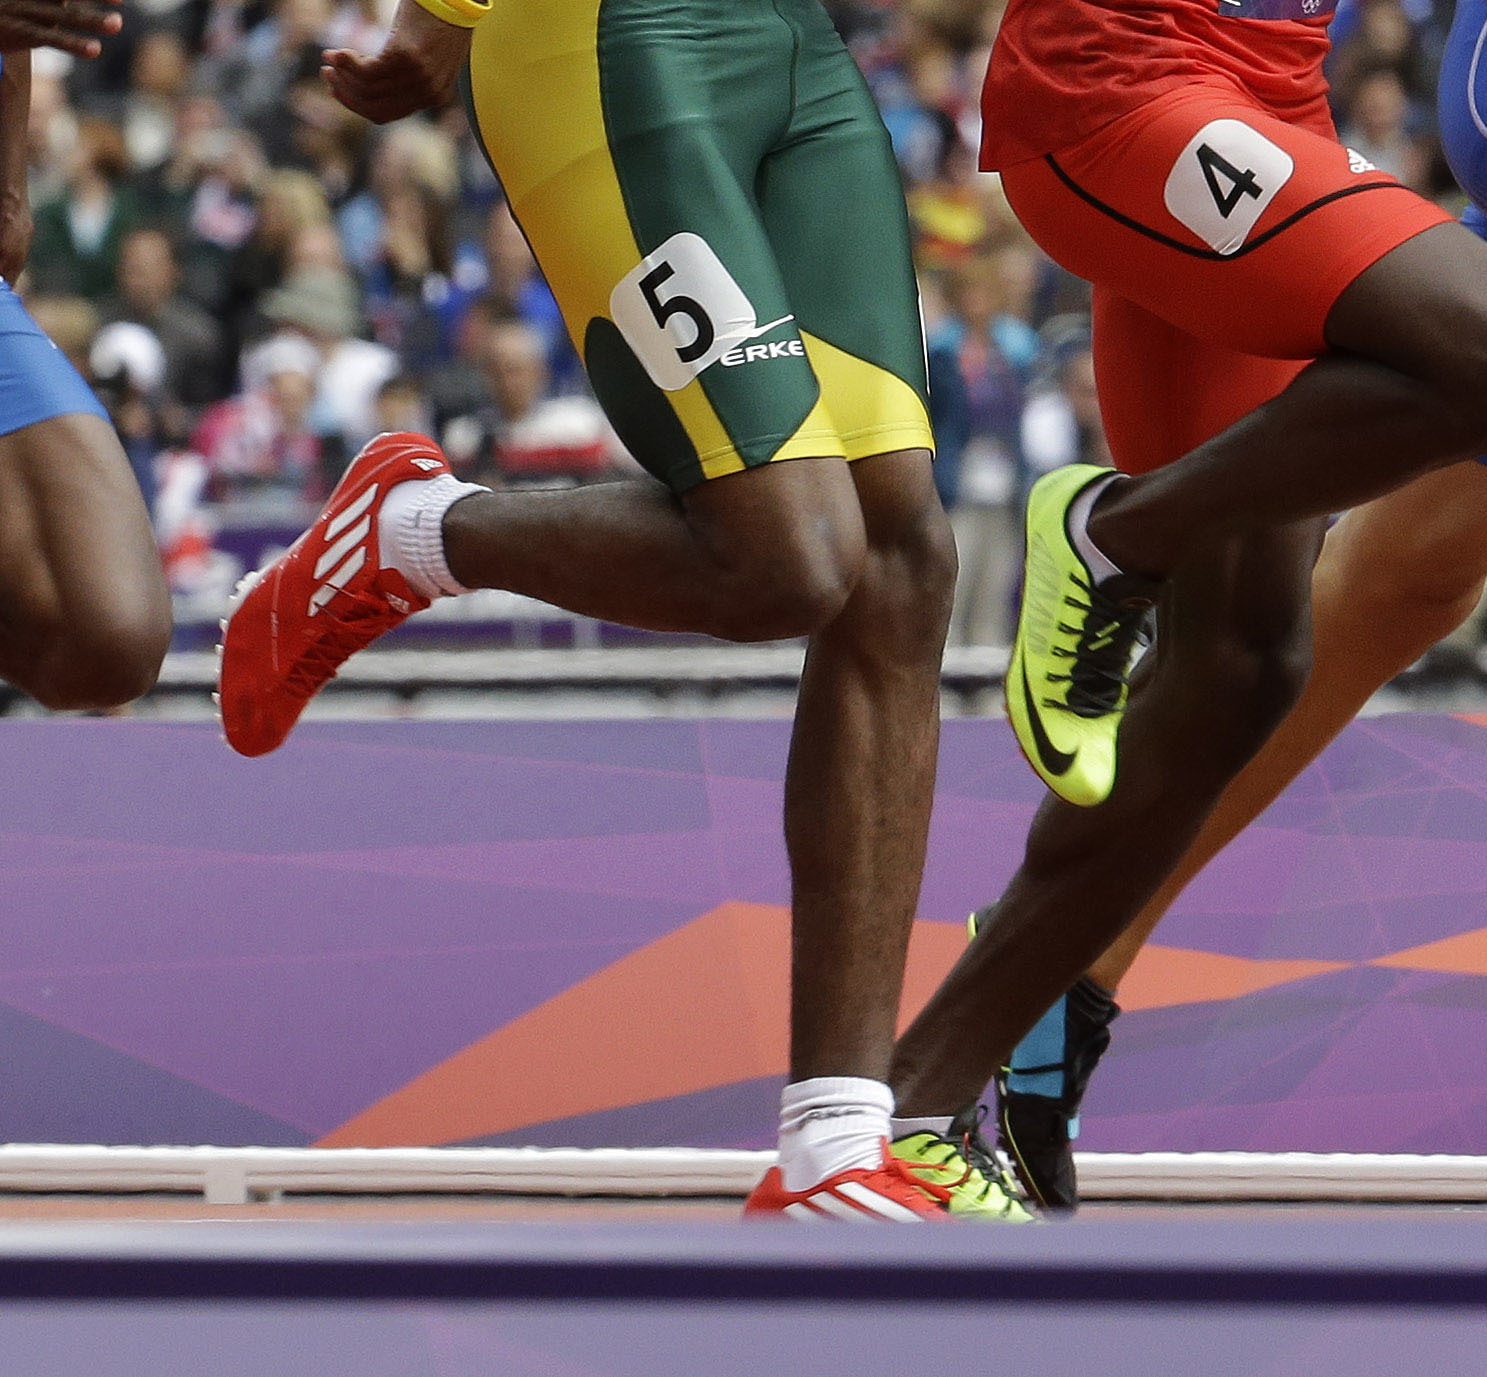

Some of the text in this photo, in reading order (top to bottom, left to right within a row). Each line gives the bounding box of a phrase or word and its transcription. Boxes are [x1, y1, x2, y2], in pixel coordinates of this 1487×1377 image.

[1196, 142, 1263, 219] 4
[638, 261, 715, 363] 5
[720, 339, 805, 367] ERKE
